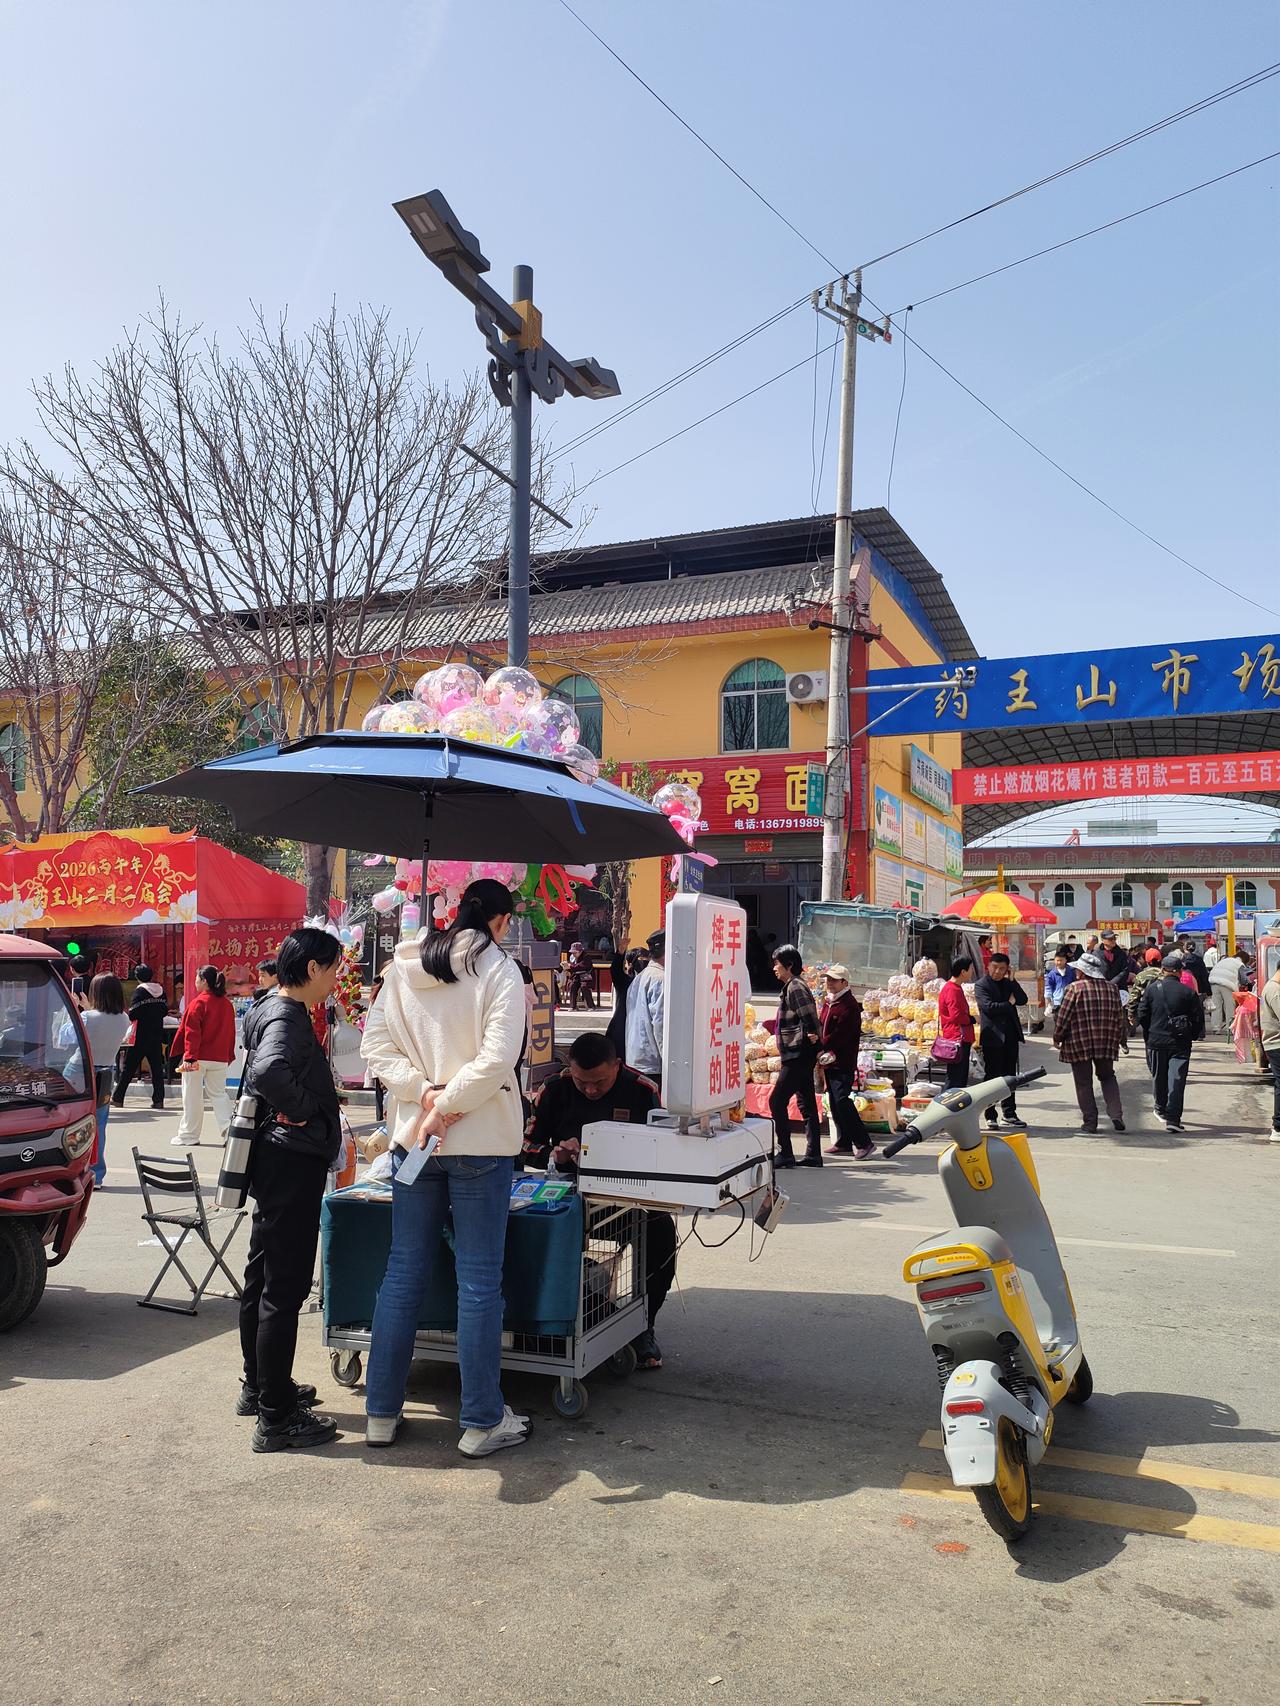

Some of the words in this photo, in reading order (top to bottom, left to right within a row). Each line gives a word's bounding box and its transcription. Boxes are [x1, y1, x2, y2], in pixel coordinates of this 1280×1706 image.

[934, 643, 1280, 720] 药王山市场
[974, 767, 1097, 796] 禁止燃放烟花爆竹
[1102, 759, 1280, 789] 违者罚款二百元至五百
[60, 855, 143, 878] 2026丙午年
[968, 852, 984, 866] 明
[994, 851, 1031, 865] 和谐
[1044, 851, 1078, 865] 自由
[1091, 850, 1129, 865] 平等
[1143, 850, 1180, 864] 公正
[1193, 849, 1233, 864] 法治
[33, 881, 173, 909] 药王山二月二庙会
[709, 914, 725, 1096] 摔不烂的
[725, 919, 742, 1090] 手机膜
[15, 1081, 47, 1096] 车辆
